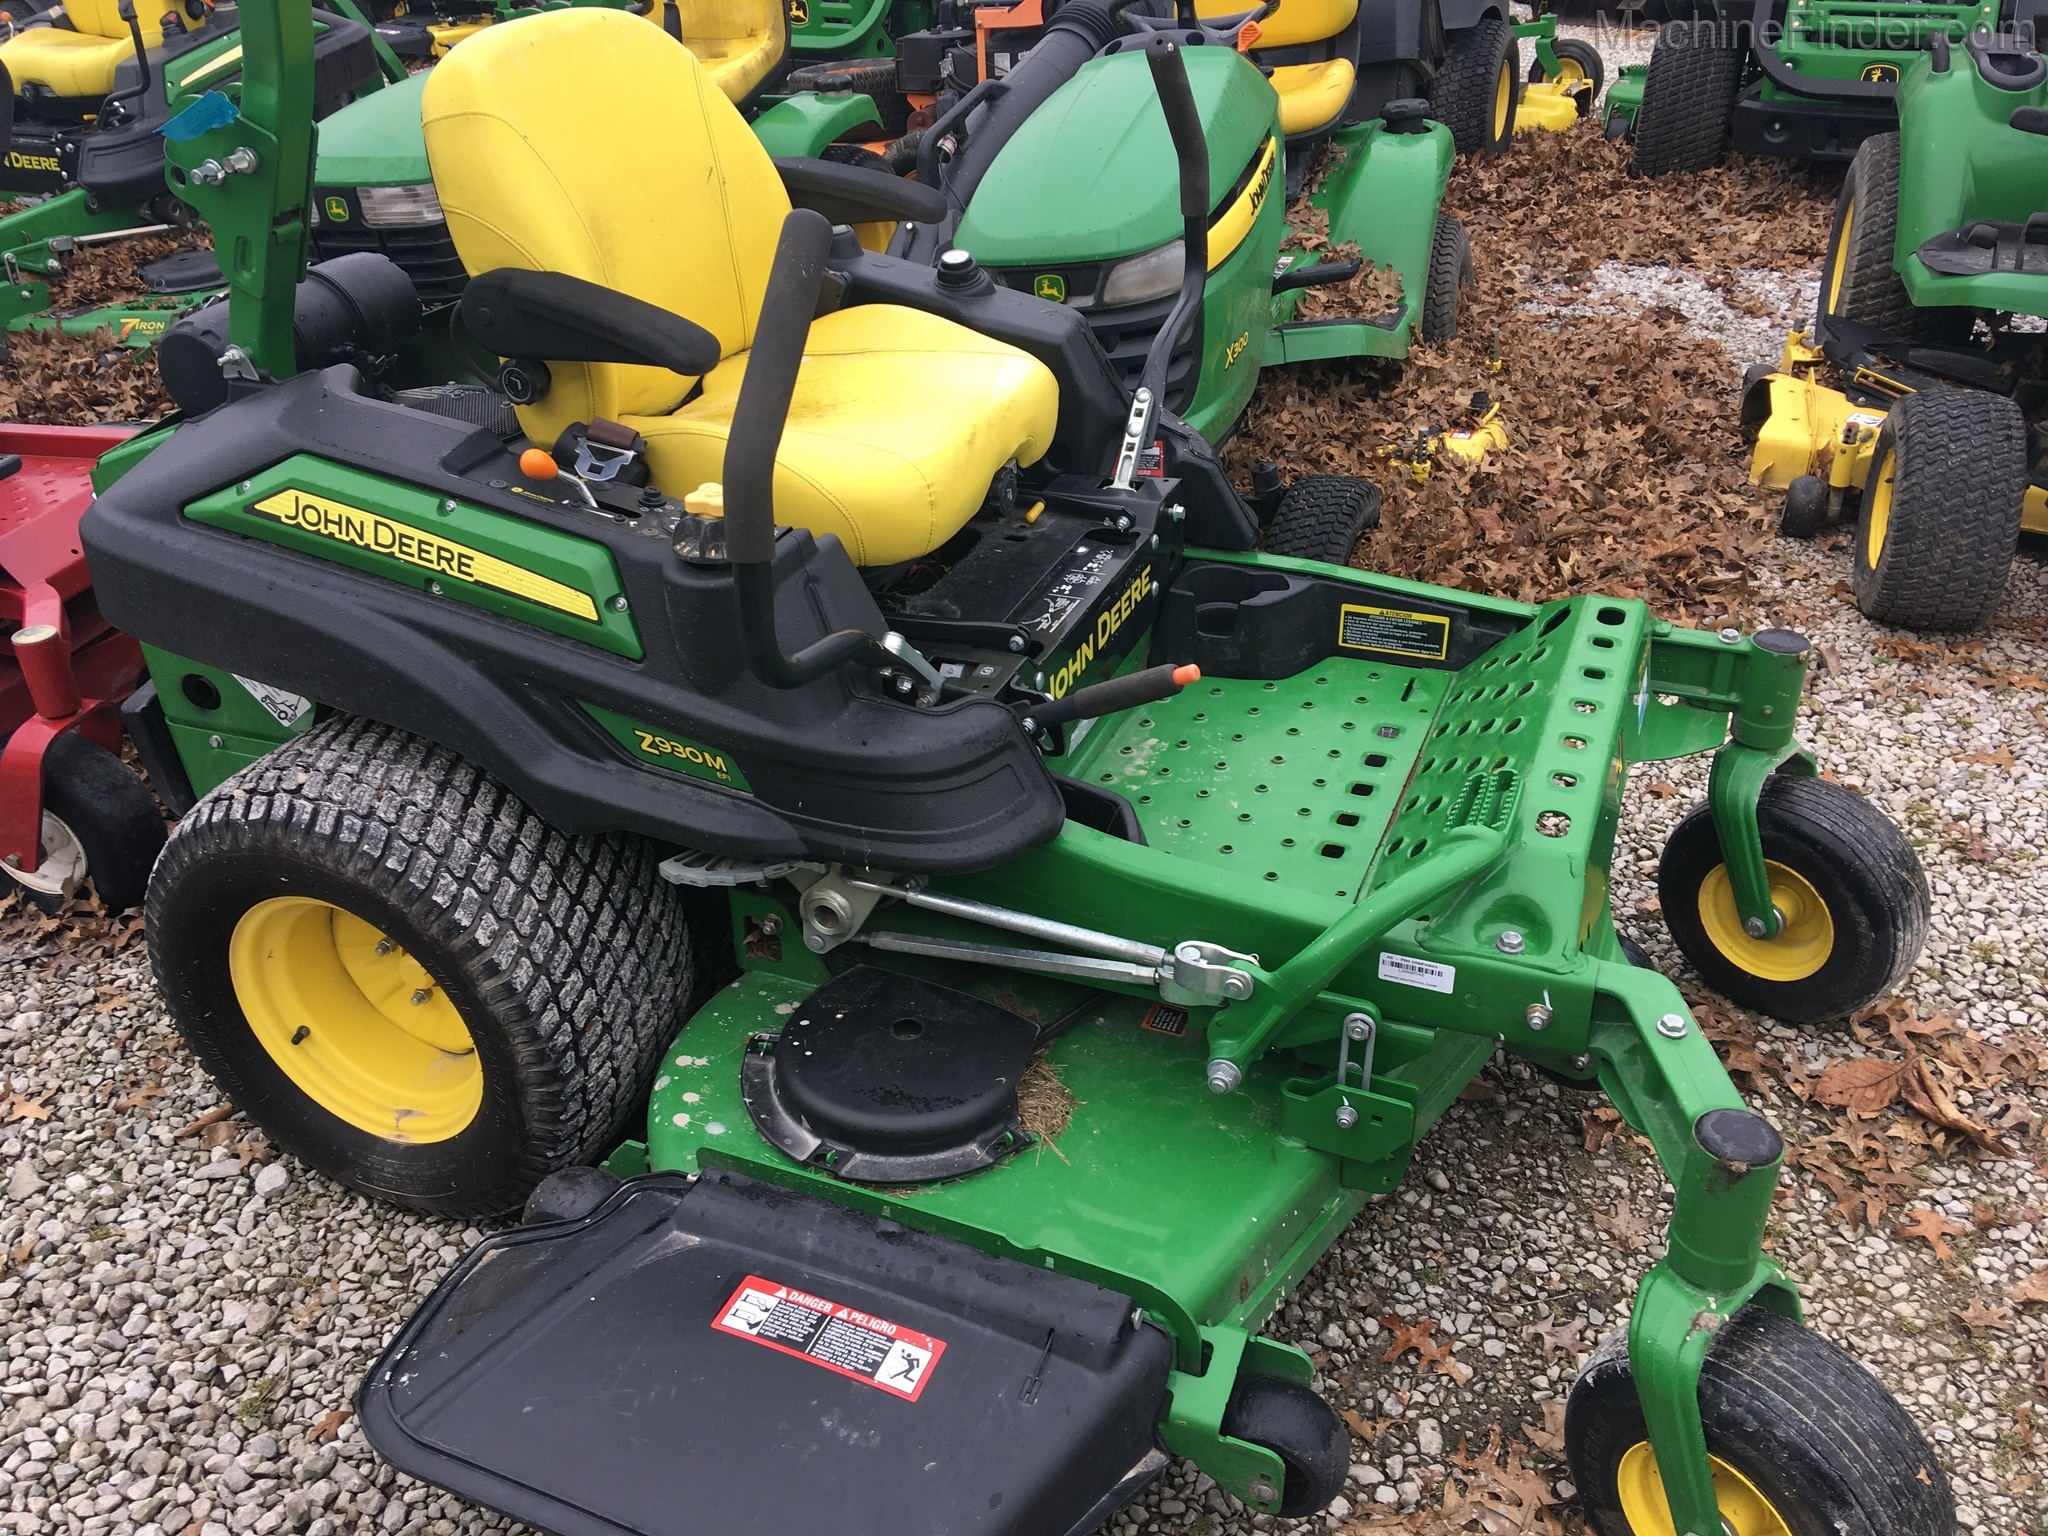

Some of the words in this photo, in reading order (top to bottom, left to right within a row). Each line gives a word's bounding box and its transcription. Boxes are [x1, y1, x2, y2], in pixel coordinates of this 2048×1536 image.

[10, 151, 61, 171] DEERE
[1224, 331, 1249, 371] X300
[285, 496, 364, 542] JOHN
[374, 520, 474, 578] DEERE
[1050, 633, 1094, 699] JOHN
[1098, 564, 1151, 650] DEERE
[788, 1292, 833, 1312] DANGER
[849, 1312, 896, 1335] PELIGRO
